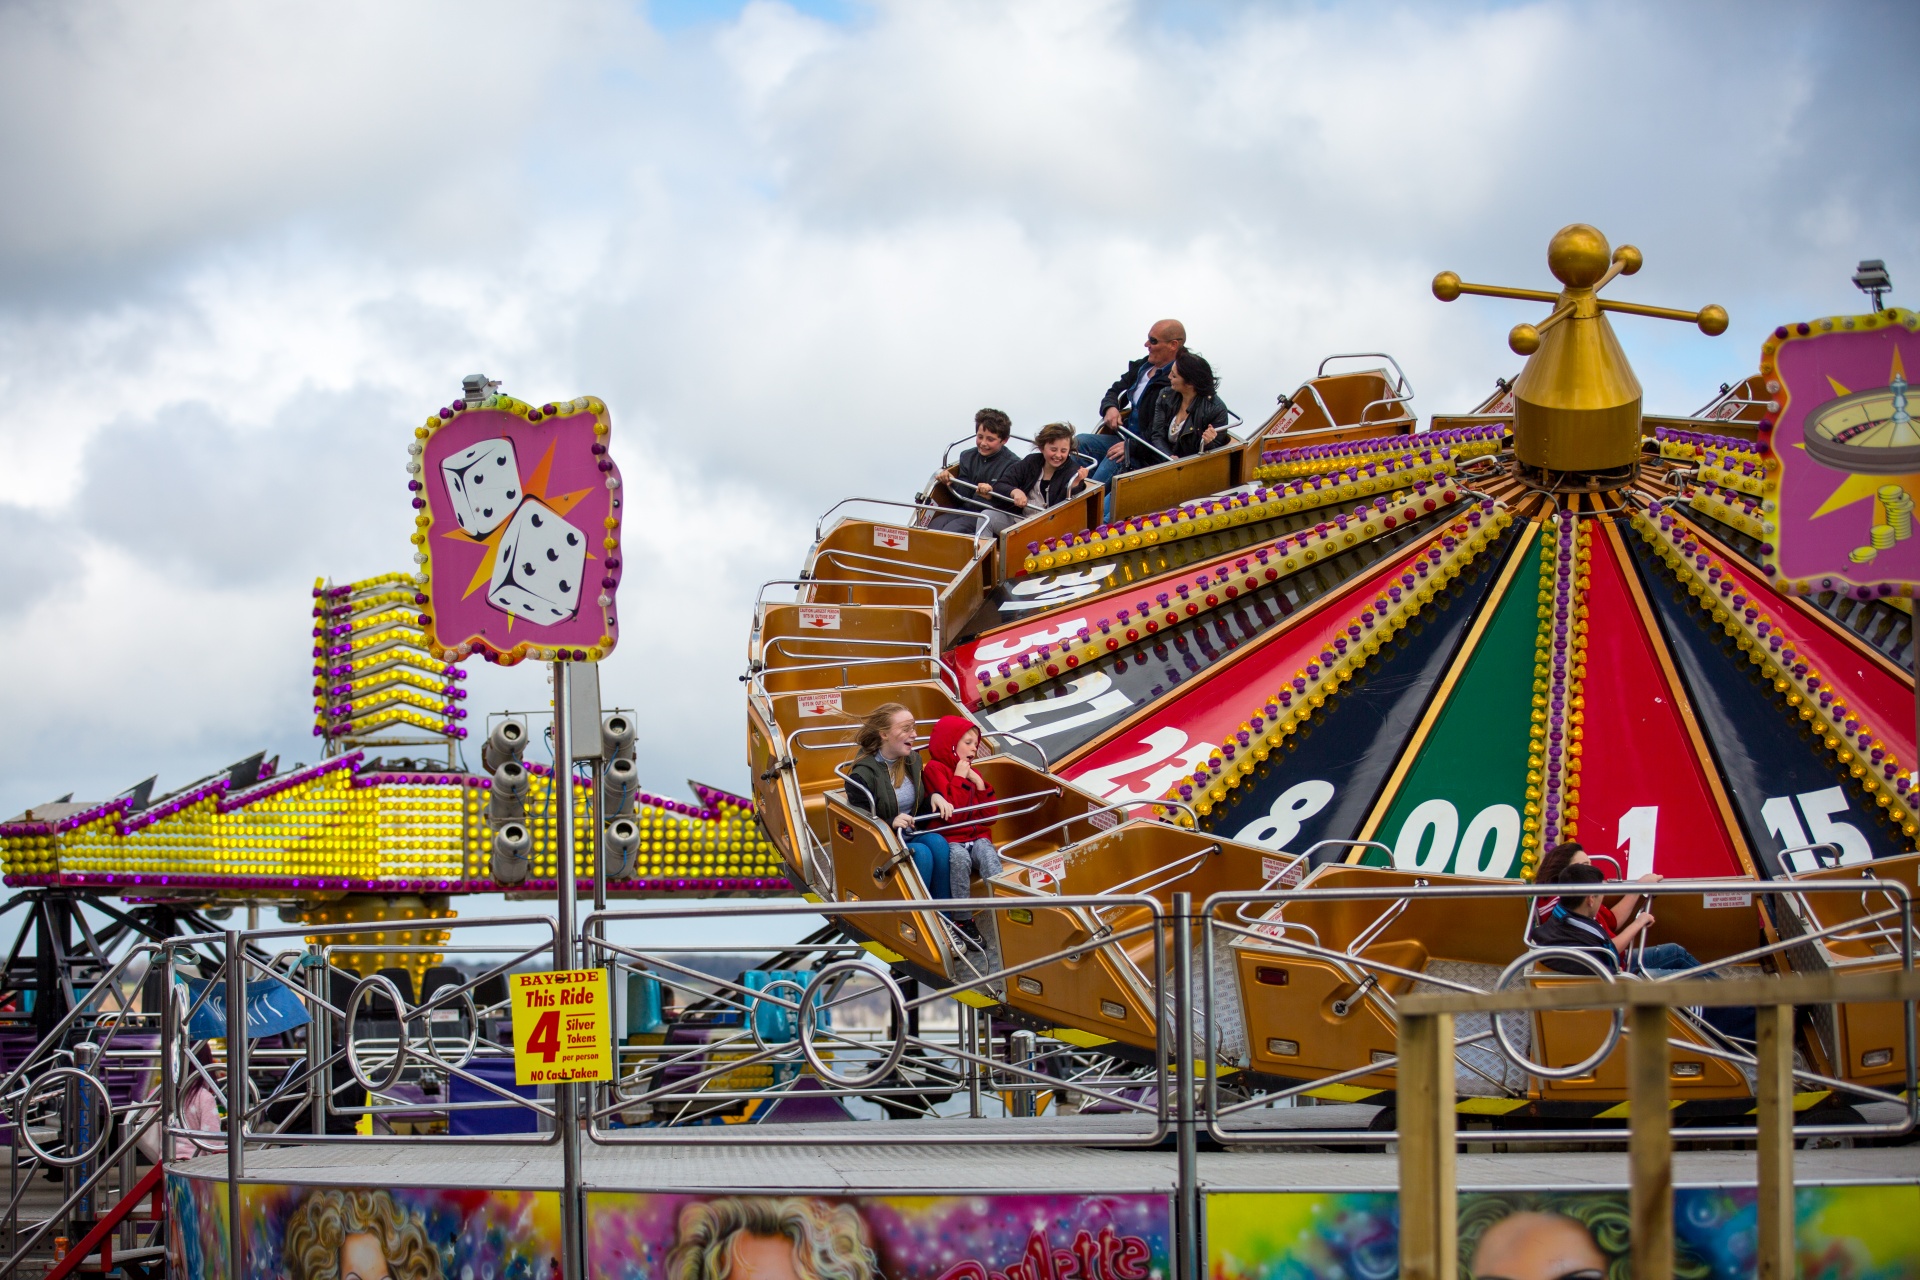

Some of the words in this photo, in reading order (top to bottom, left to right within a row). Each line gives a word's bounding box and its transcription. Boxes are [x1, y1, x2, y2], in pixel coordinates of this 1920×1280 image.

[1270, 418, 1286, 435] CAUTION
[1282, 418, 1294, 430] POINT
[985, 671, 1134, 746] 27
[1070, 726, 1221, 811] 23
[1232, 780, 1334, 850] 8
[1394, 798, 1520, 878] 00
[1760, 786, 1873, 872] 15
[1616, 806, 1658, 880] 1
[520, 972, 598, 986] BAYSIDE
[526, 989, 555, 1007] This
[560, 987, 594, 1005] Ride
[566, 1018, 595, 1031] Silver
[526, 1011, 560, 1063] 4
[567, 1033, 596, 1044] Tokens
[562, 1054, 574, 1062] per
[576, 1053, 598, 1062] person
[530, 1071, 543, 1081] NO
[546, 1069, 567, 1080] Cash
[571, 1067, 598, 1079] Taken
